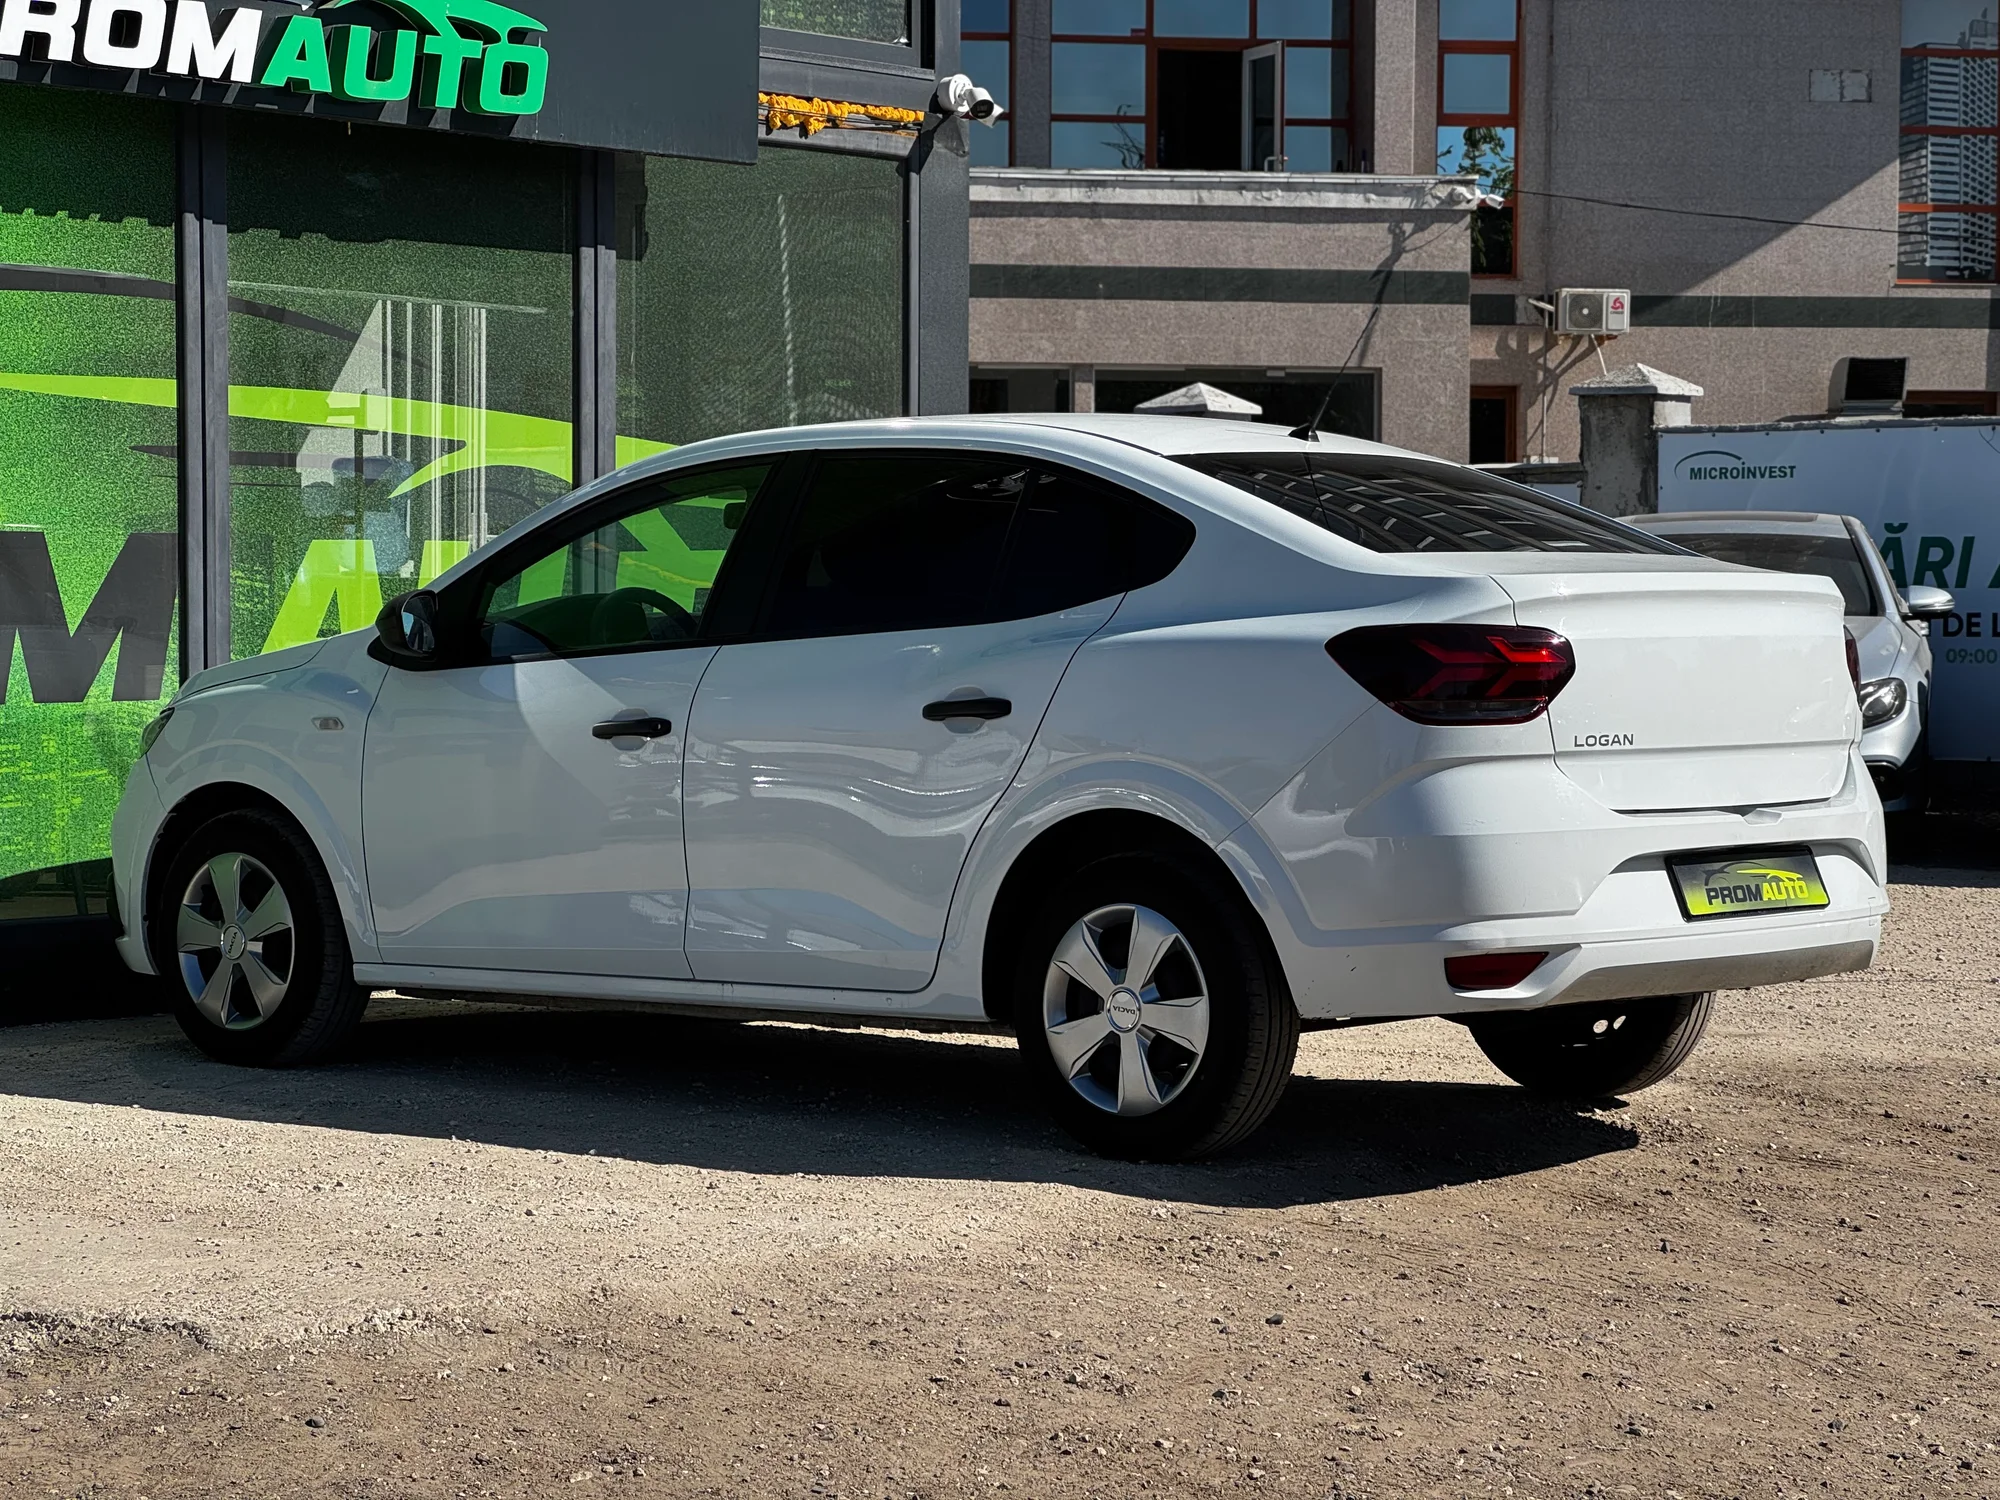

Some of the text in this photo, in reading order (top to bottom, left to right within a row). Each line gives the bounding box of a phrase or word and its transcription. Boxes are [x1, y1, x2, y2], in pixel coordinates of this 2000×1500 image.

[1689, 462, 1796, 480] MICROINVEST
[1943, 611, 1981, 637] DE
[1946, 648, 1998, 664] 09:00
[1574, 734, 1633, 747] LOGAN
[1705, 880, 1809, 906] PROMAUTO
[228, 931, 238, 954] DACIA
[1113, 1005, 1135, 1015] DACIA
